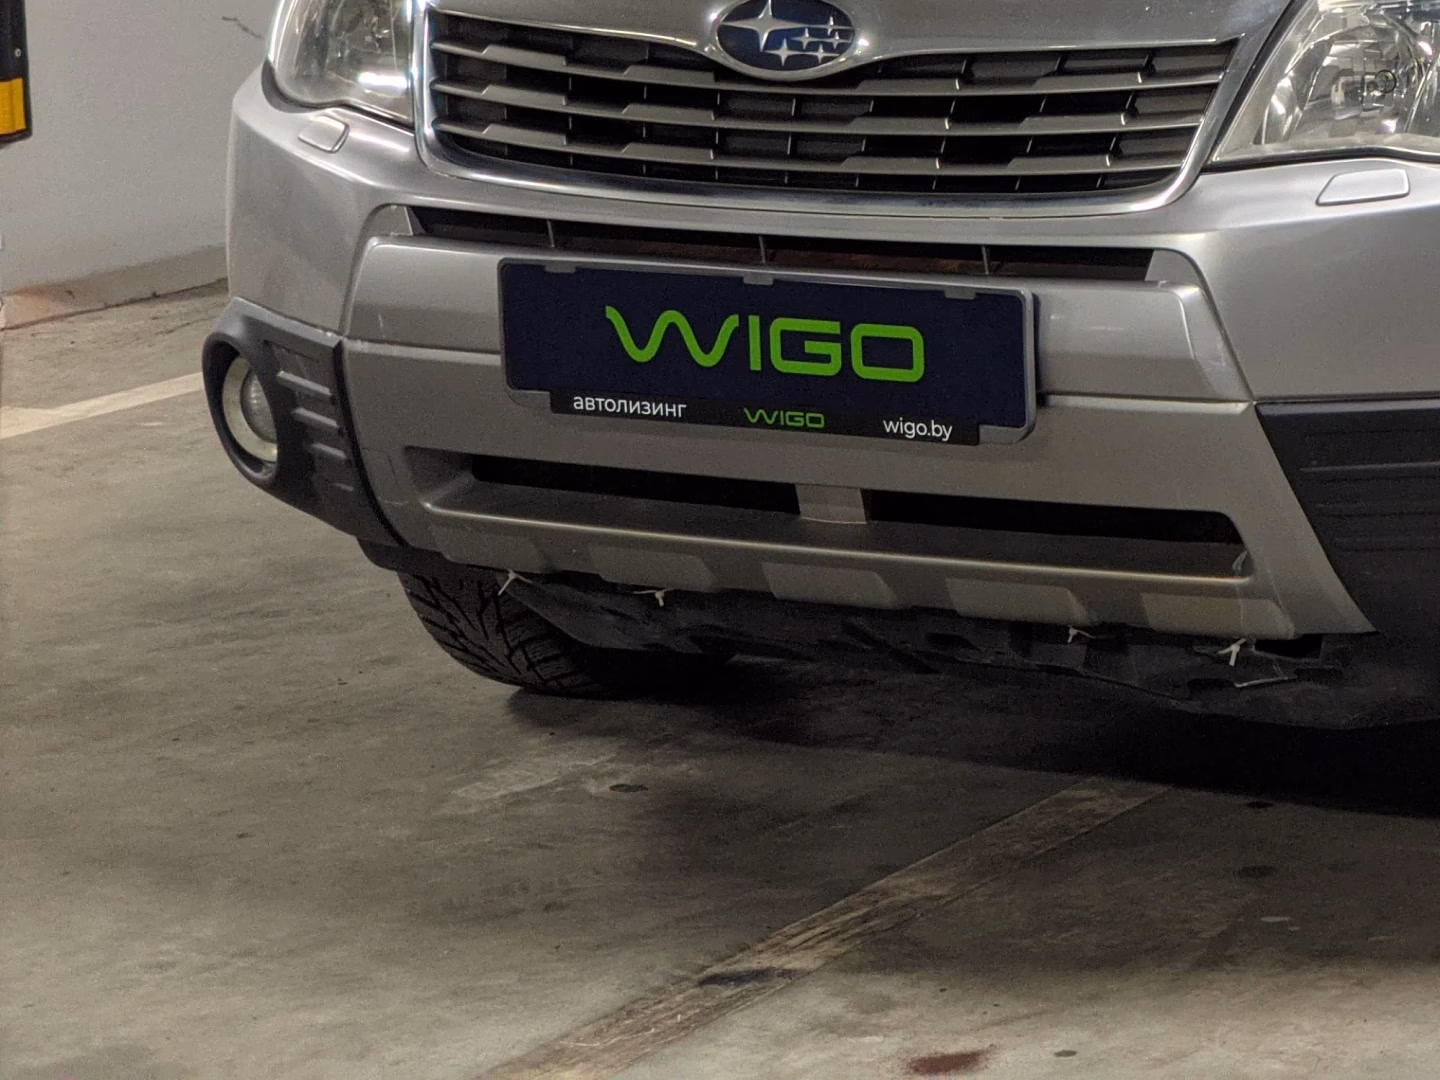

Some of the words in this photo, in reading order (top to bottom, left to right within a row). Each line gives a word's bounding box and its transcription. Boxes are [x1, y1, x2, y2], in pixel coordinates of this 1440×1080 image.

[605, 306, 925, 383] WIGO
[573, 396, 687, 418] автолизинг
[744, 407, 825, 429] WIGO
[883, 417, 953, 442] wigo.by
